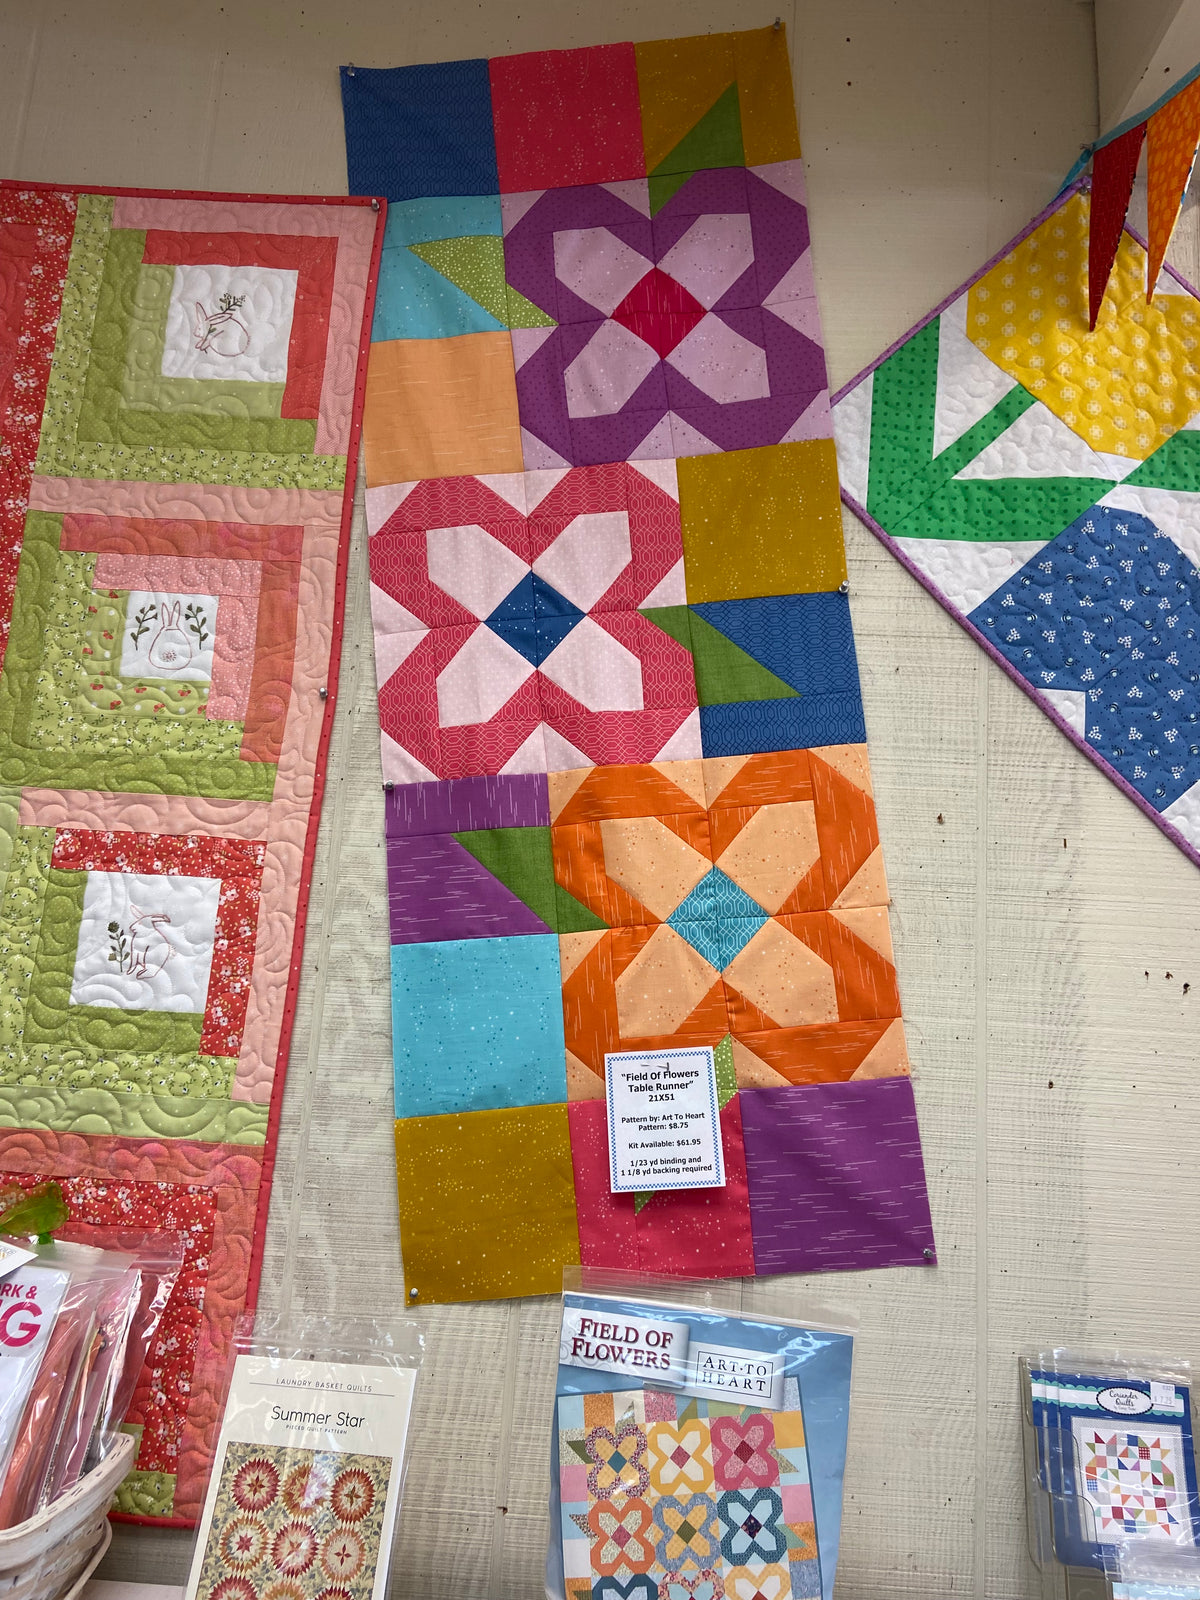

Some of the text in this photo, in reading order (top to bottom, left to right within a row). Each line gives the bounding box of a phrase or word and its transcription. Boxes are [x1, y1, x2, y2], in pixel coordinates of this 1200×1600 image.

[650, 1071, 661, 1080] Of
[663, 1070, 699, 1079] Flowers
[628, 1083, 654, 1093] Table
[648, 1093, 675, 1103] 21X51
[621, 1116, 648, 1124] Pattern
[649, 1114, 660, 1123] by:
[638, 1122, 689, 1132] Pattern: $8.75
[640, 1141, 675, 1149] Available:
[676, 1138, 701, 1147] $61.95
[630, 1159, 648, 1167] 1/23
[649, 1158, 658, 1167] yd
[660, 1157, 686, 1166] binding
[627, 1168, 641, 1176] 1/8
[642, 1168, 651, 1176] yd
[652, 1166, 680, 1175] backing
[682, 1164, 712, 1174] required
[26, 1286, 37, 1299] &
[578, 1317, 673, 1348] FIELD OF
[571, 1337, 671, 1370] FLOWERS
[276, 1378, 373, 1392] LAUNDRY BASKET QUILTS
[702, 1372, 766, 1391] HEART
[1109, 1390, 1139, 1400] Coriander
[271, 1406, 365, 1428] Summer Star
